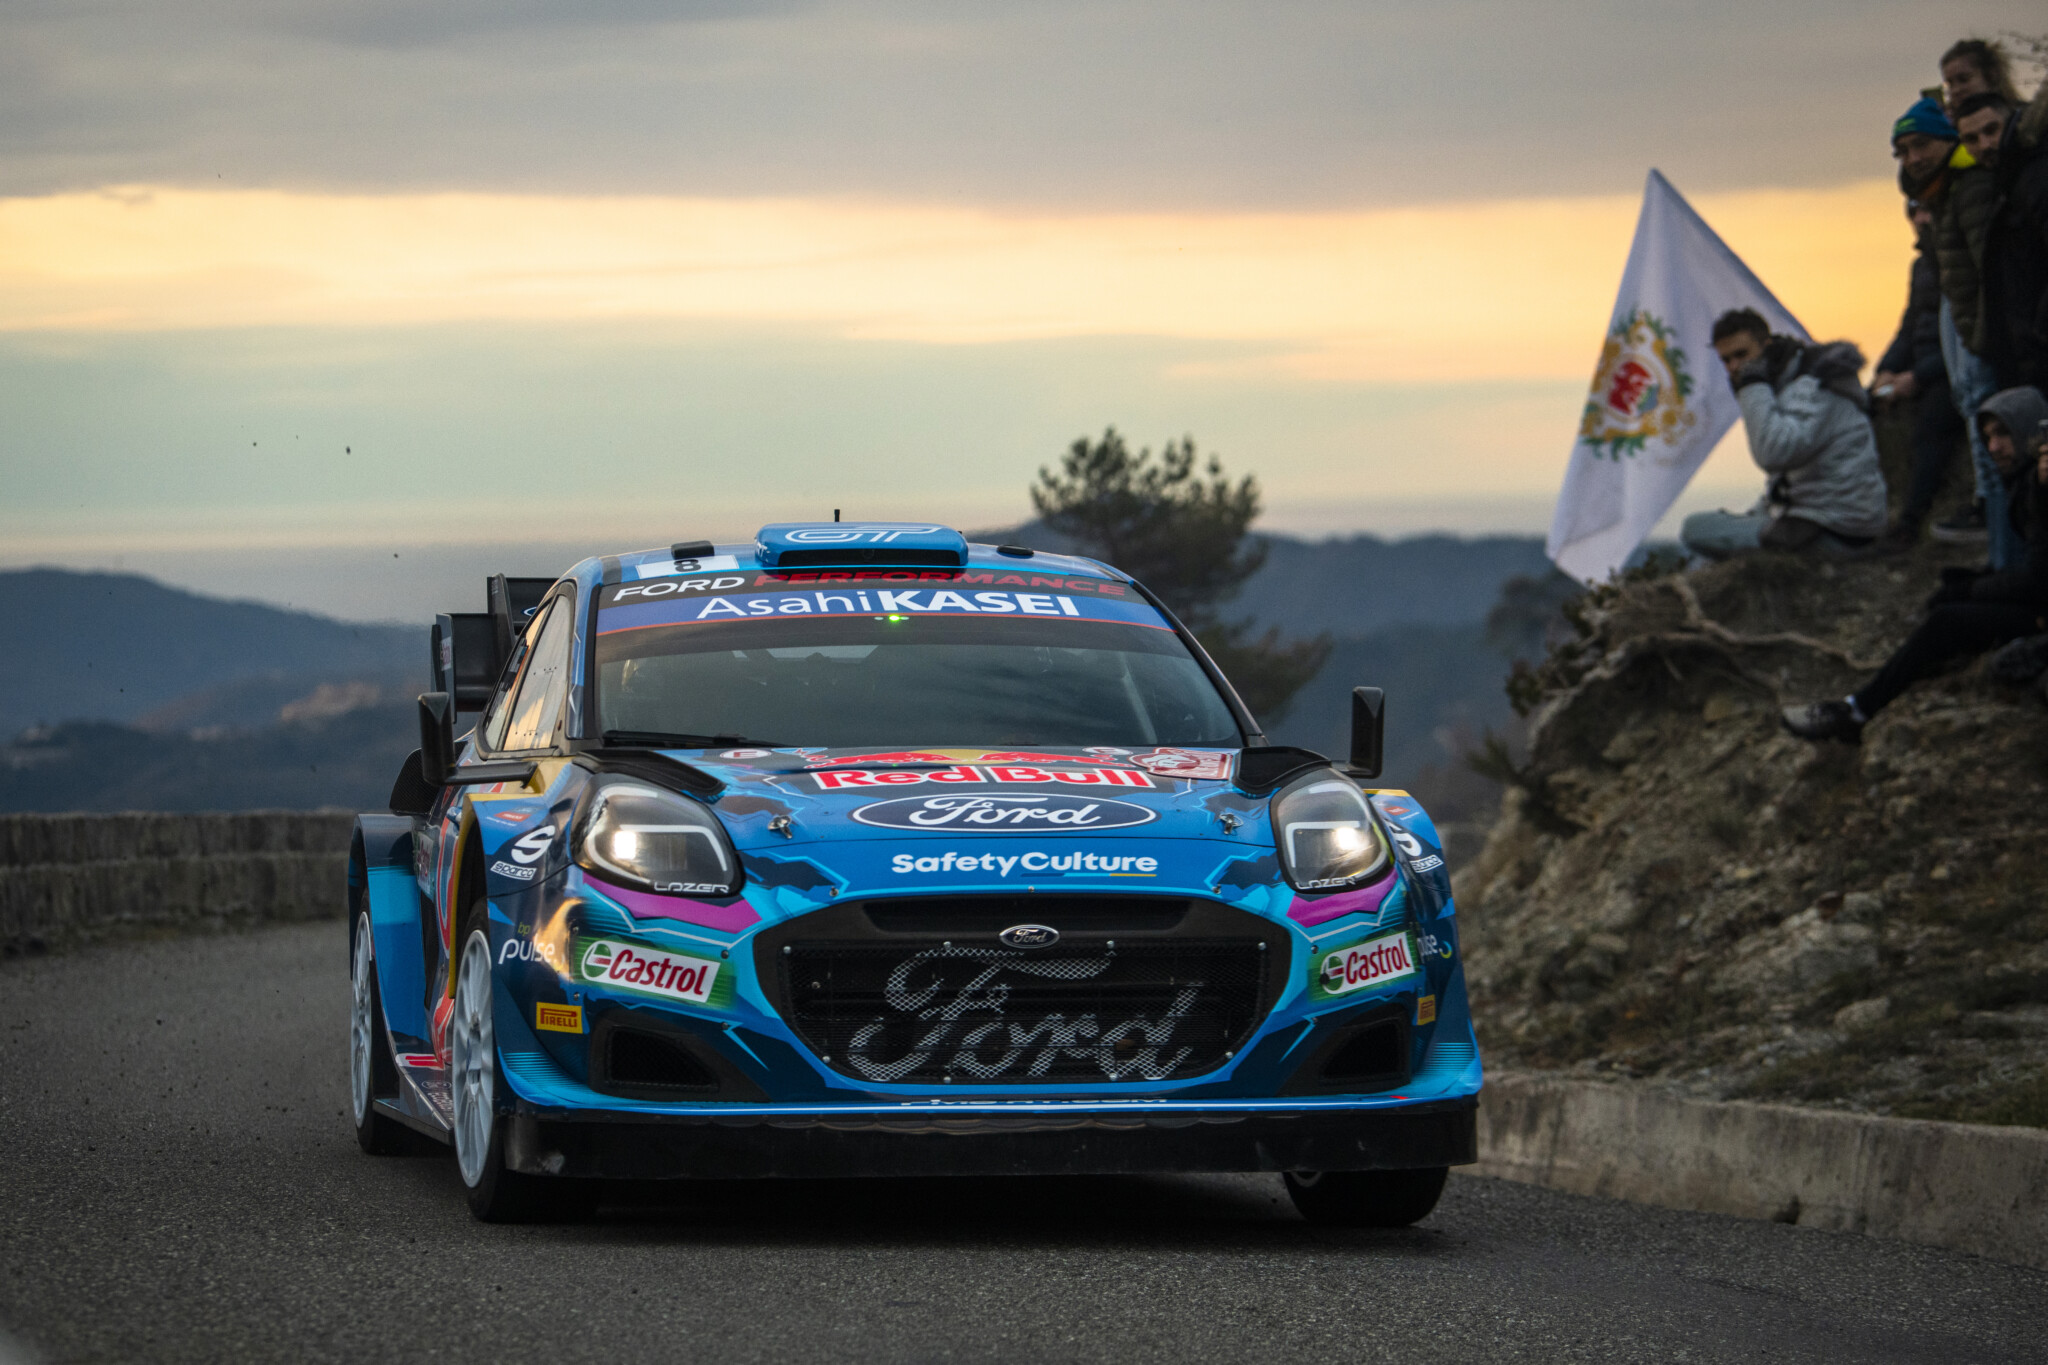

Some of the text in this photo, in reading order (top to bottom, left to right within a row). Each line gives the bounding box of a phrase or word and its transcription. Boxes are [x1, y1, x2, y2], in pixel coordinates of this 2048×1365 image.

[612, 571, 1126, 602] FORD PERFORMANCE
[811, 765, 1157, 790] Red Bull
[908, 796, 1102, 825] Ford
[493, 862, 535, 879] sparco
[891, 851, 1159, 878] SafetyCulture
[653, 881, 730, 894] LAZER
[1295, 875, 1357, 890] LAZER
[518, 922, 531, 936] bp
[1012, 928, 1048, 943] Ford
[498, 933, 556, 965] pulse
[1346, 938, 1411, 985] Castrol
[608, 948, 709, 996] Castrol
[540, 1007, 578, 1028] PIRELLI
[848, 946, 1204, 1081] Ford
